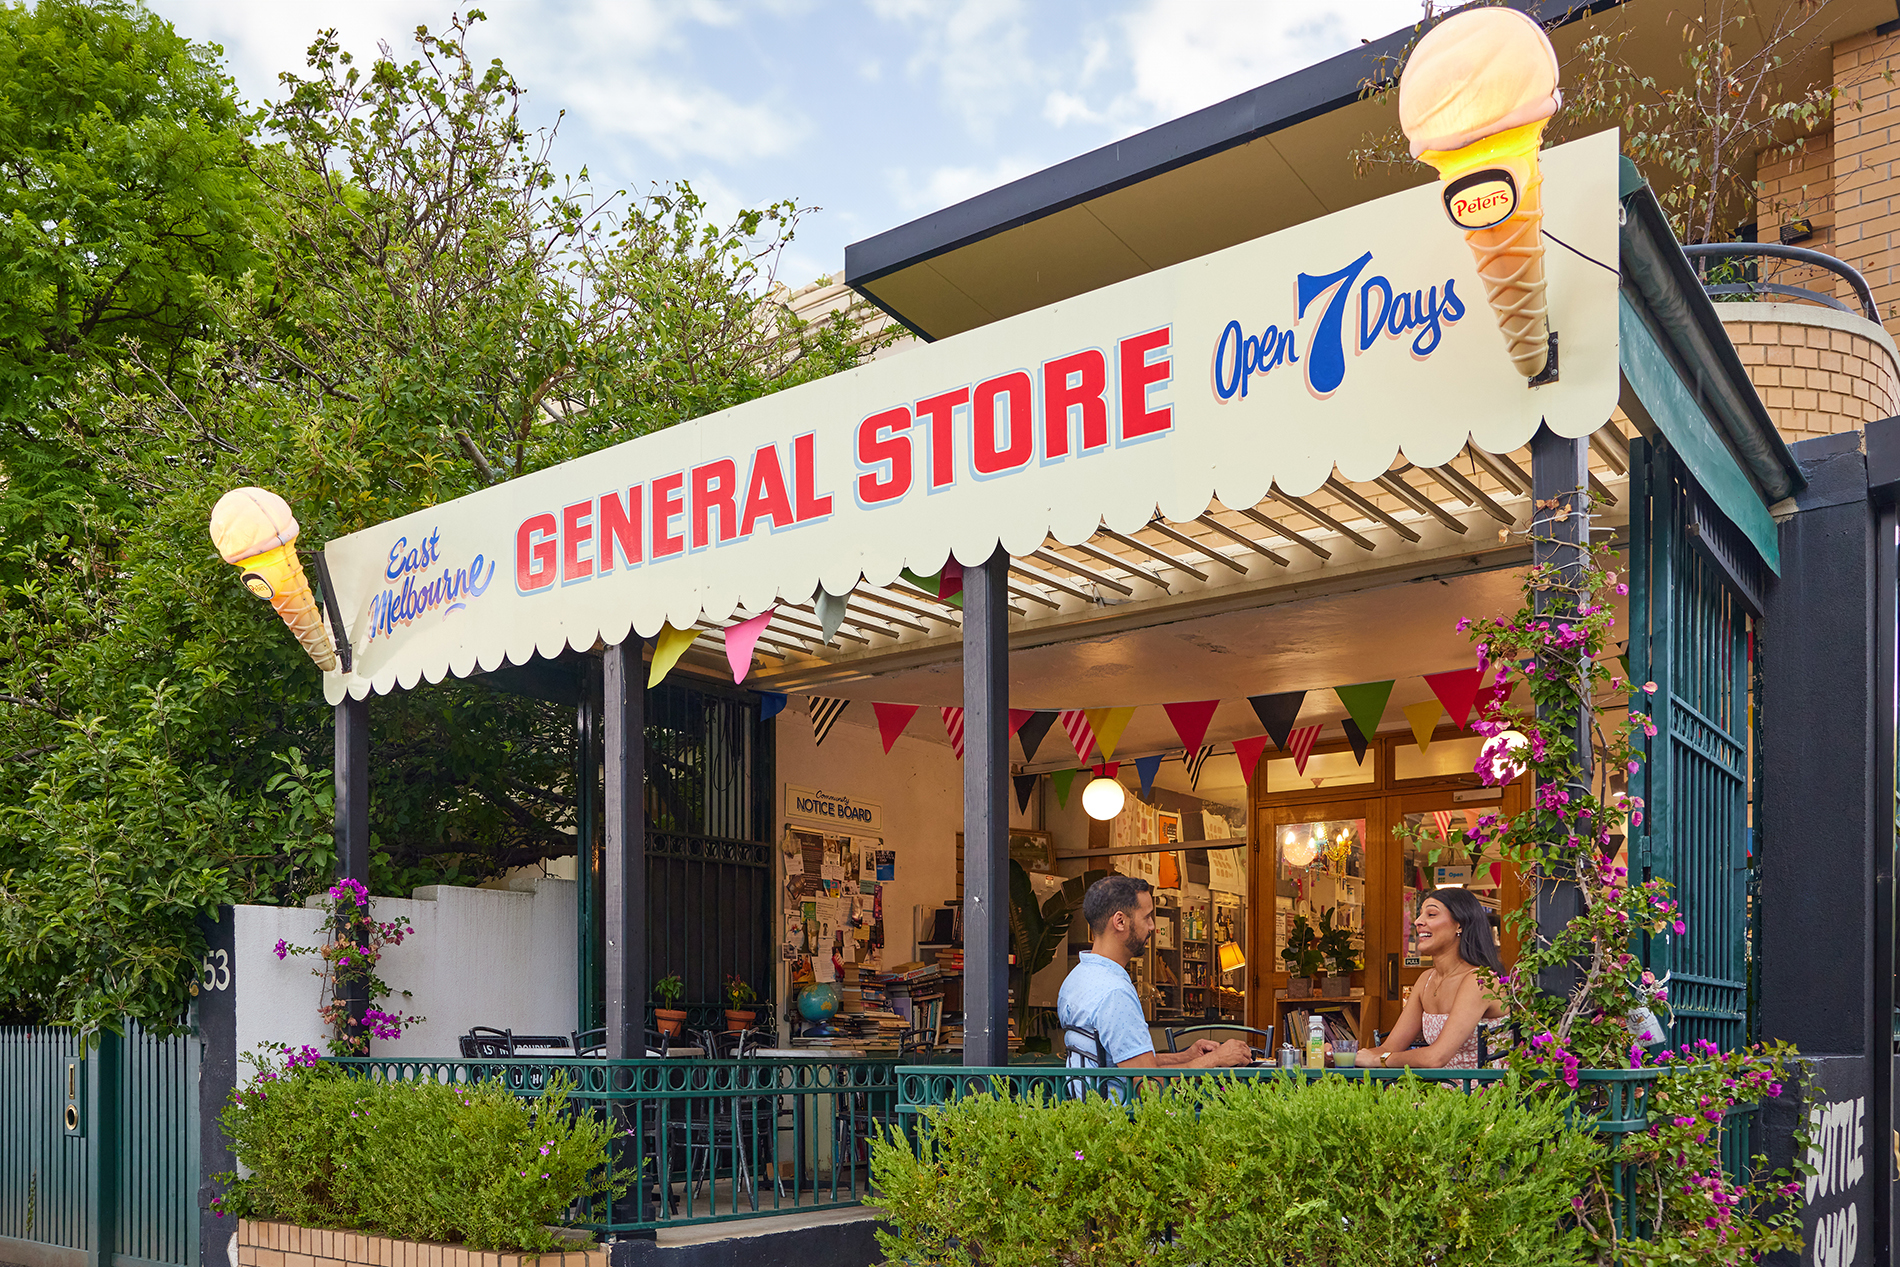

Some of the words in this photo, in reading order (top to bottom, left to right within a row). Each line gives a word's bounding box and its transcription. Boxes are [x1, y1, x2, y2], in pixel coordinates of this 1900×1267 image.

[1453, 189, 1509, 217] Peters
[1214, 319, 1300, 400] Open
[1296, 250, 1374, 394] 7
[1359, 274, 1466, 356] Days
[514, 430, 834, 596] GENERAL
[856, 324, 1173, 507] STORE
[385, 526, 441, 582] East
[369, 553, 496, 640] Melbourne
[796, 796, 835, 816] NOTICE
[837, 804, 873, 823] BOARD
[815, 789, 851, 805] Community
[1448, 871, 1464, 879] Open
[203, 948, 230, 991] 53
[1805, 1096, 1865, 1206] BOTTLE
